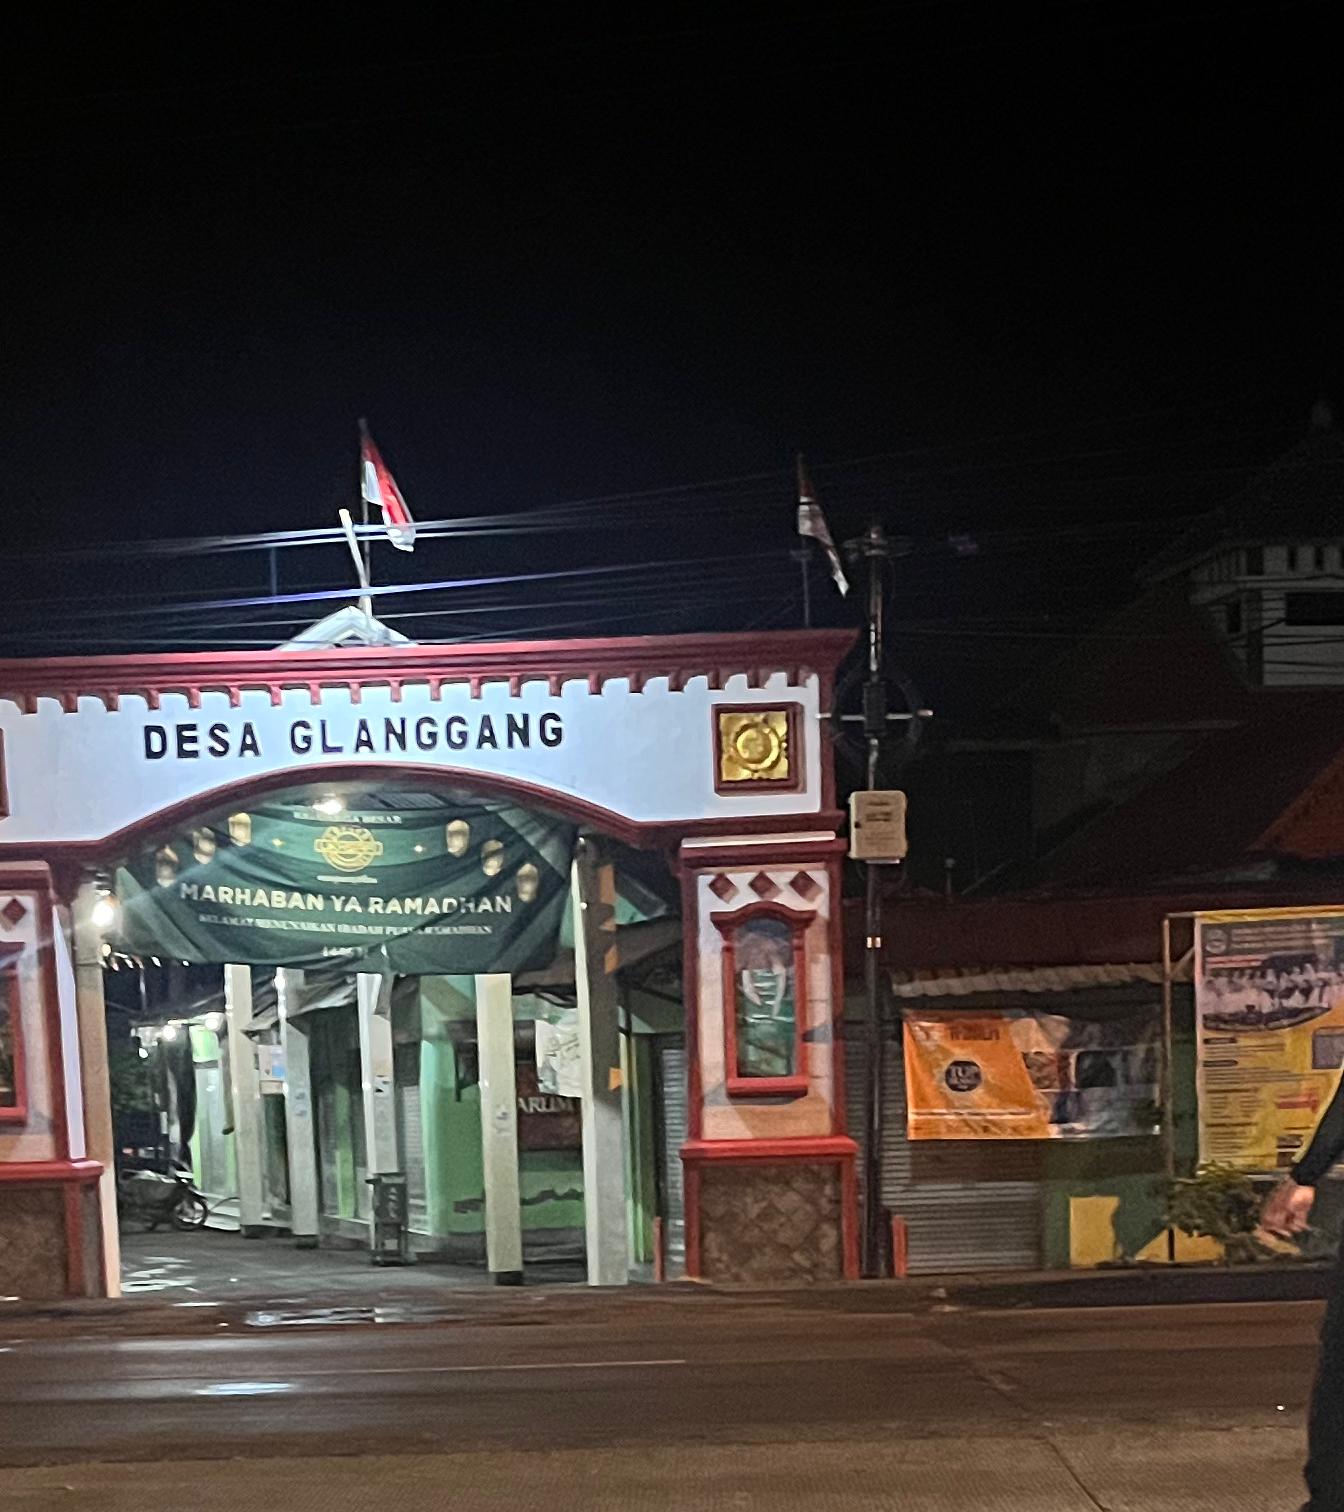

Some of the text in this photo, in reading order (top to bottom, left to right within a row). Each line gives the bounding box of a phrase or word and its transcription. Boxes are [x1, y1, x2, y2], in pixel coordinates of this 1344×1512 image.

[143, 712, 564, 760] DESA GLANGGANG
[180, 882, 512, 915] MARHABAN YA RAMADHAN
